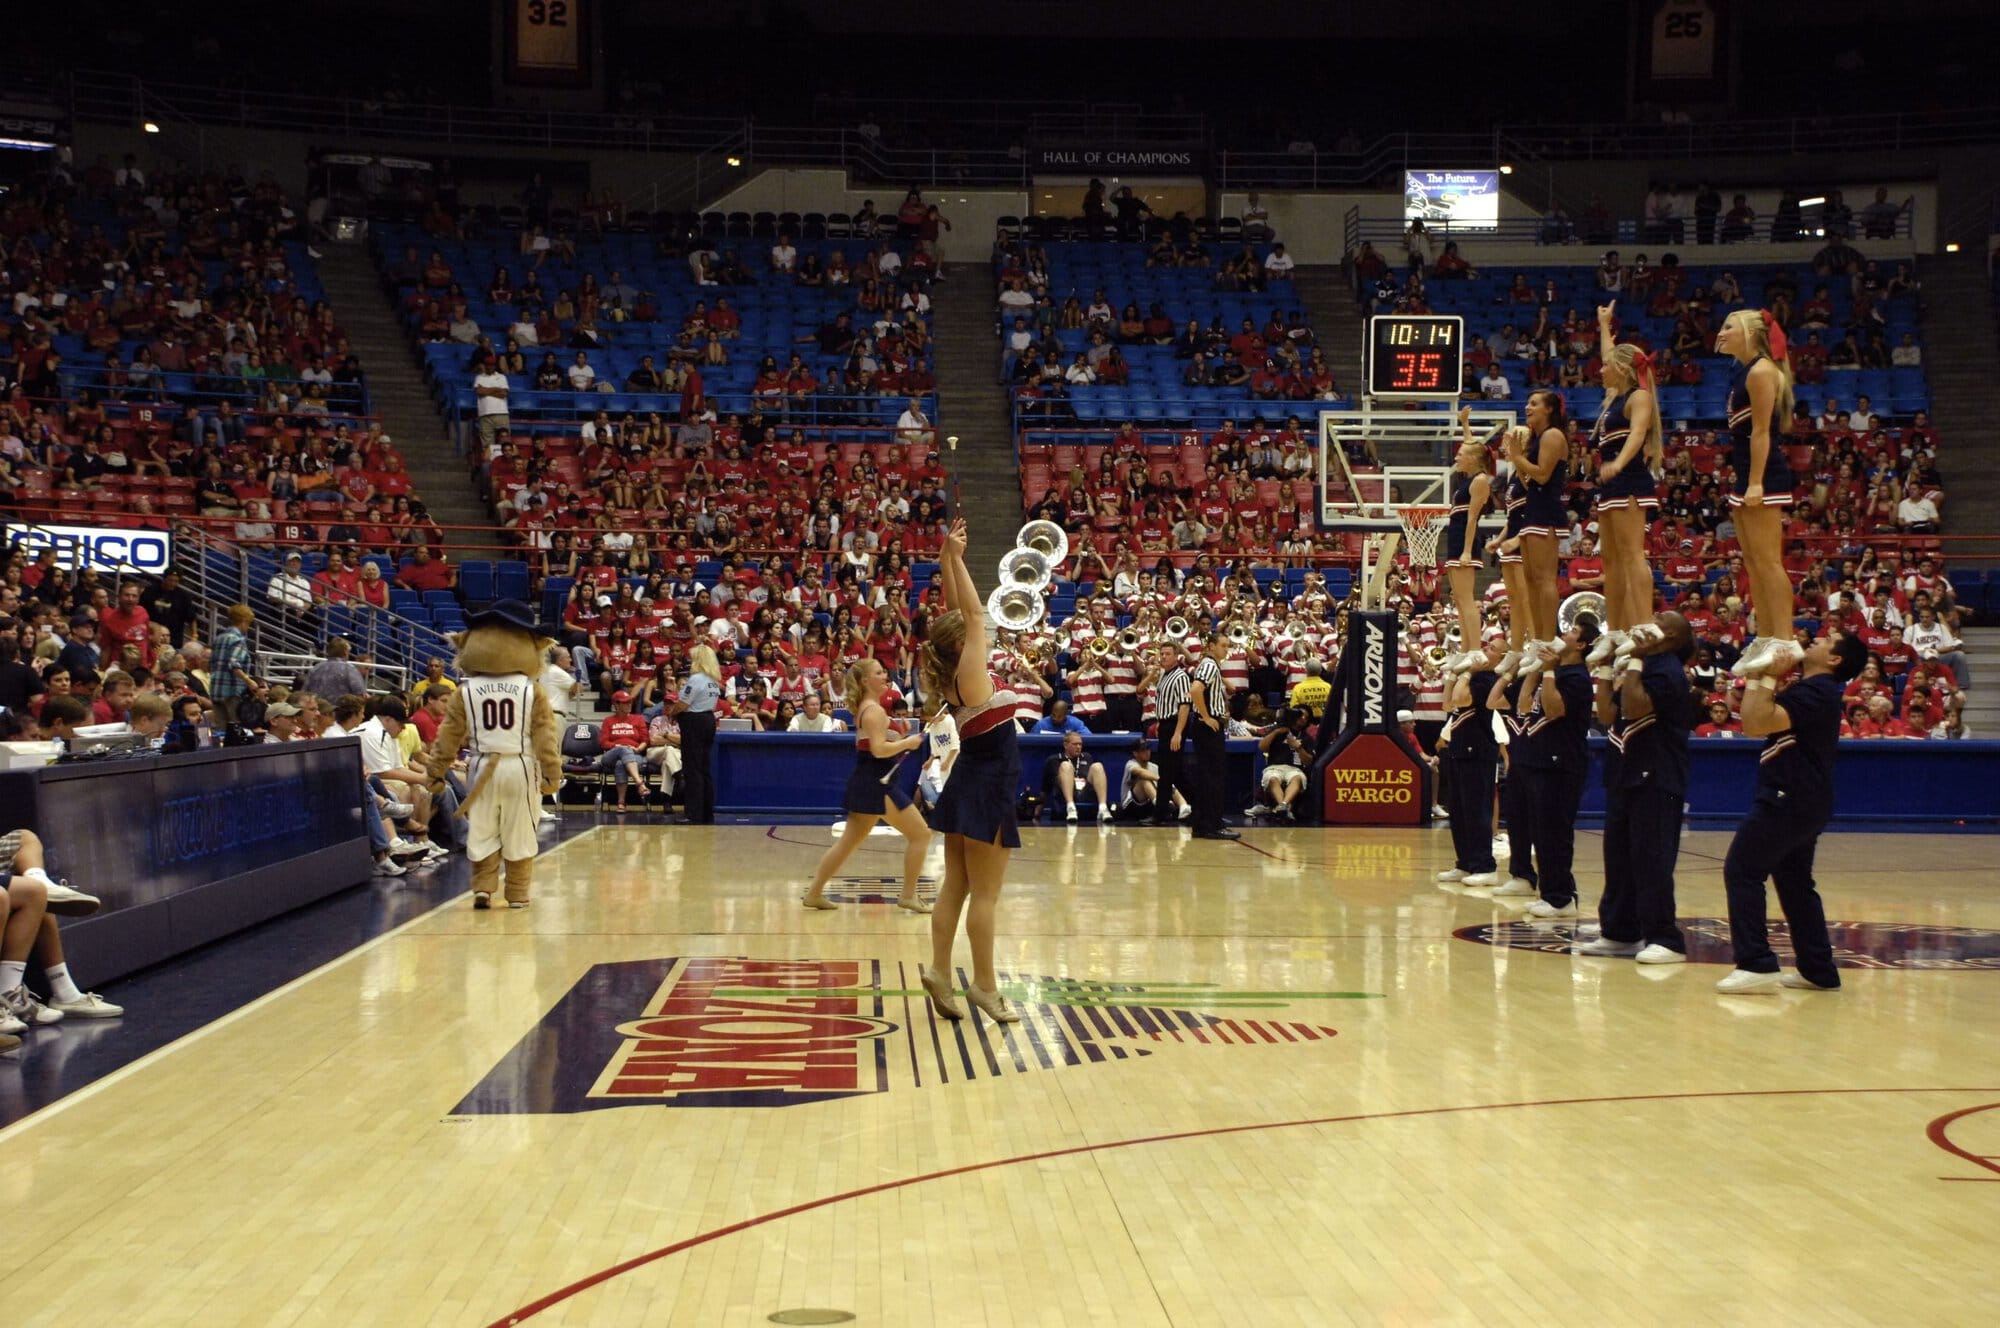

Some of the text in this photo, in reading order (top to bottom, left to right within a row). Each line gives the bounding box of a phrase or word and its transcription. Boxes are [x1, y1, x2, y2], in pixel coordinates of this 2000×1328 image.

[528, 0, 566, 26] 32
[1665, 12, 1702, 38] 25
[0, 119, 56, 135] EPSI
[1043, 151, 1190, 165] HALL OF CHAMPIONS
[1426, 173, 1443, 183] The
[1390, 324, 1452, 345] 10:14
[1392, 353, 1440, 387] 35
[139, 410, 152, 422] 19
[1184, 435, 1198, 446] 21
[1684, 435, 1699, 447] 22
[285, 525, 299, 539] 19
[12, 531, 165, 568] GEICO
[1364, 620, 1385, 725] ARIZONA
[476, 683, 519, 696] WILBUR
[482, 698, 514, 730] 00
[1333, 768, 1413, 785] WELLS
[1335, 788, 1412, 804] FARGO
